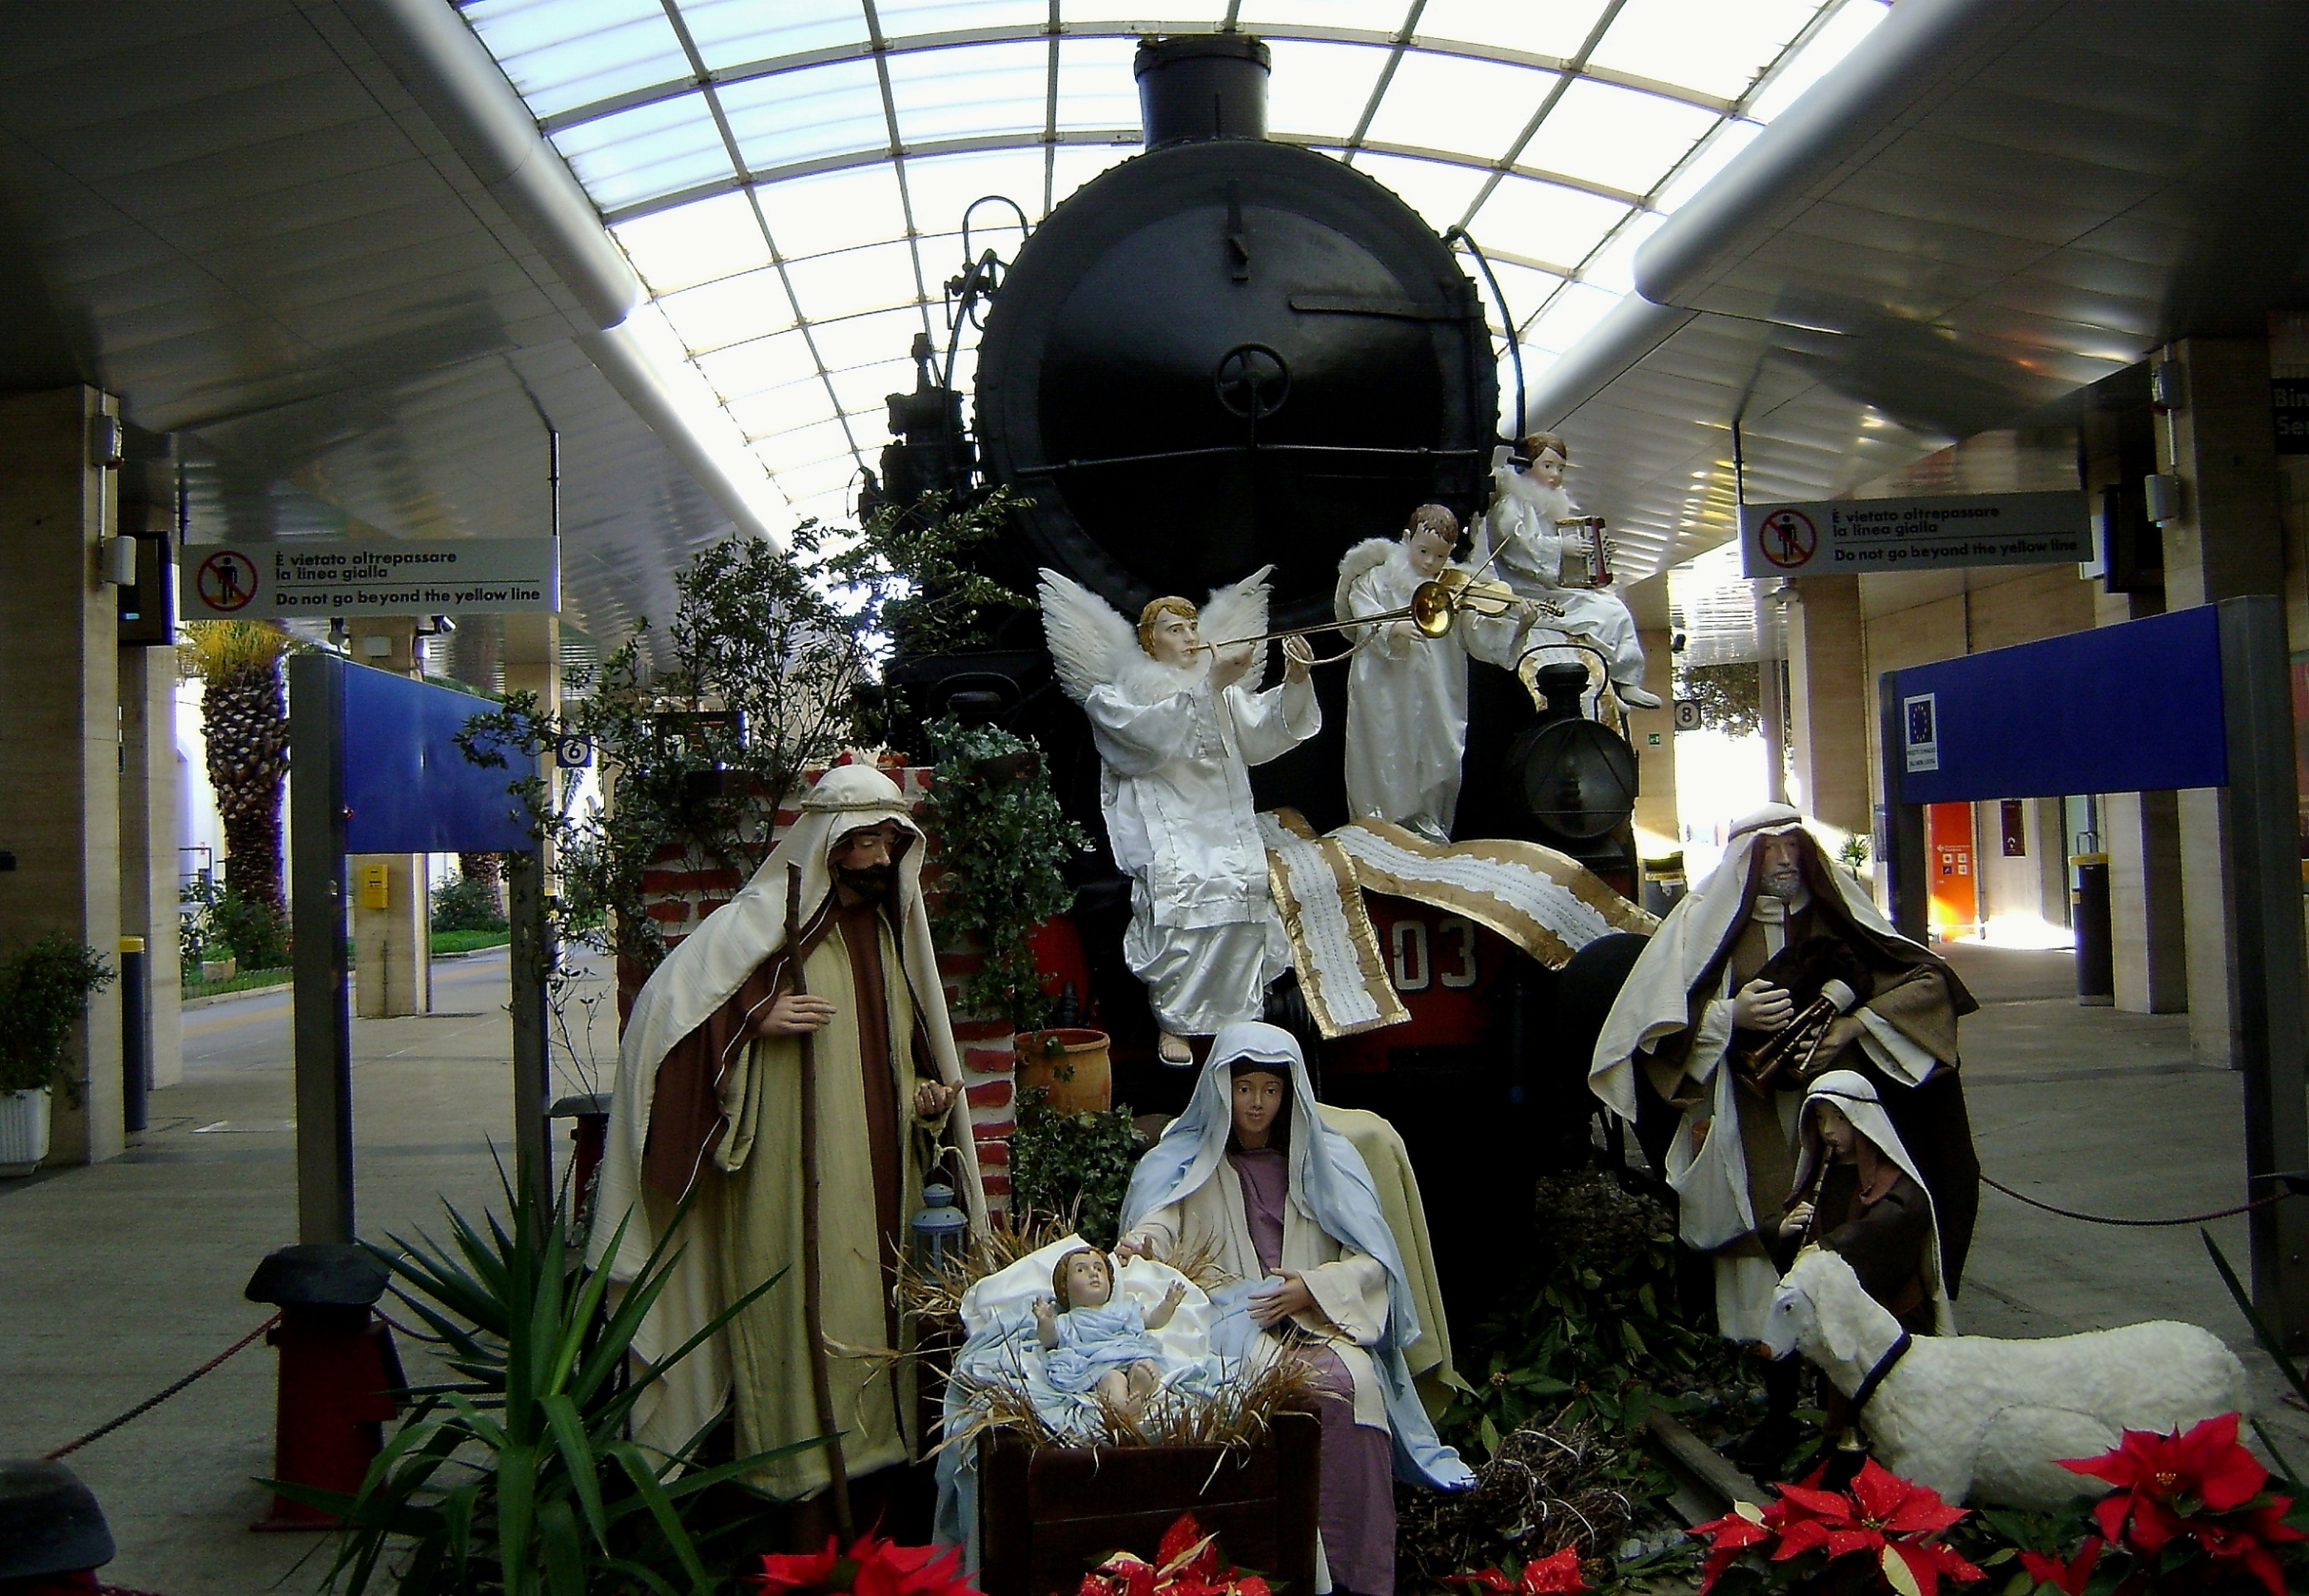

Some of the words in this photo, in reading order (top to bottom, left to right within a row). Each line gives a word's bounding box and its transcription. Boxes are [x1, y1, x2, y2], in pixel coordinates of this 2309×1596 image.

[1846, 510, 1898, 523] vietato
[1904, 507, 2000, 523] oltrepassare
[1833, 524, 1847, 538] la
[1853, 523, 1891, 536] linea
[1896, 520, 1938, 538] gialla
[276, 551, 284, 566] È
[291, 553, 346, 566] vietato
[352, 551, 456, 567] oltrepassare
[1834, 548, 1855, 561] Do
[1858, 548, 1883, 560] not
[1888, 549, 1906, 562] go
[1910, 542, 1968, 559] beyond
[1973, 542, 1996, 555] the
[2000, 540, 2047, 556] yellow
[2051, 539, 2077, 552] line
[276, 567, 291, 581] la
[297, 567, 337, 580] linea
[343, 565, 388, 581] gialla
[276, 593, 297, 605] Do
[302, 593, 327, 605] not
[333, 594, 353, 607] go
[358, 589, 420, 606] beyond
[425, 589, 451, 601] the
[456, 588, 507, 605] yellow
[511, 587, 540, 600] line
[1682, 706, 1692, 722] 8
[568, 742, 582, 759] 6
[1372, 919, 1477, 991] 03
